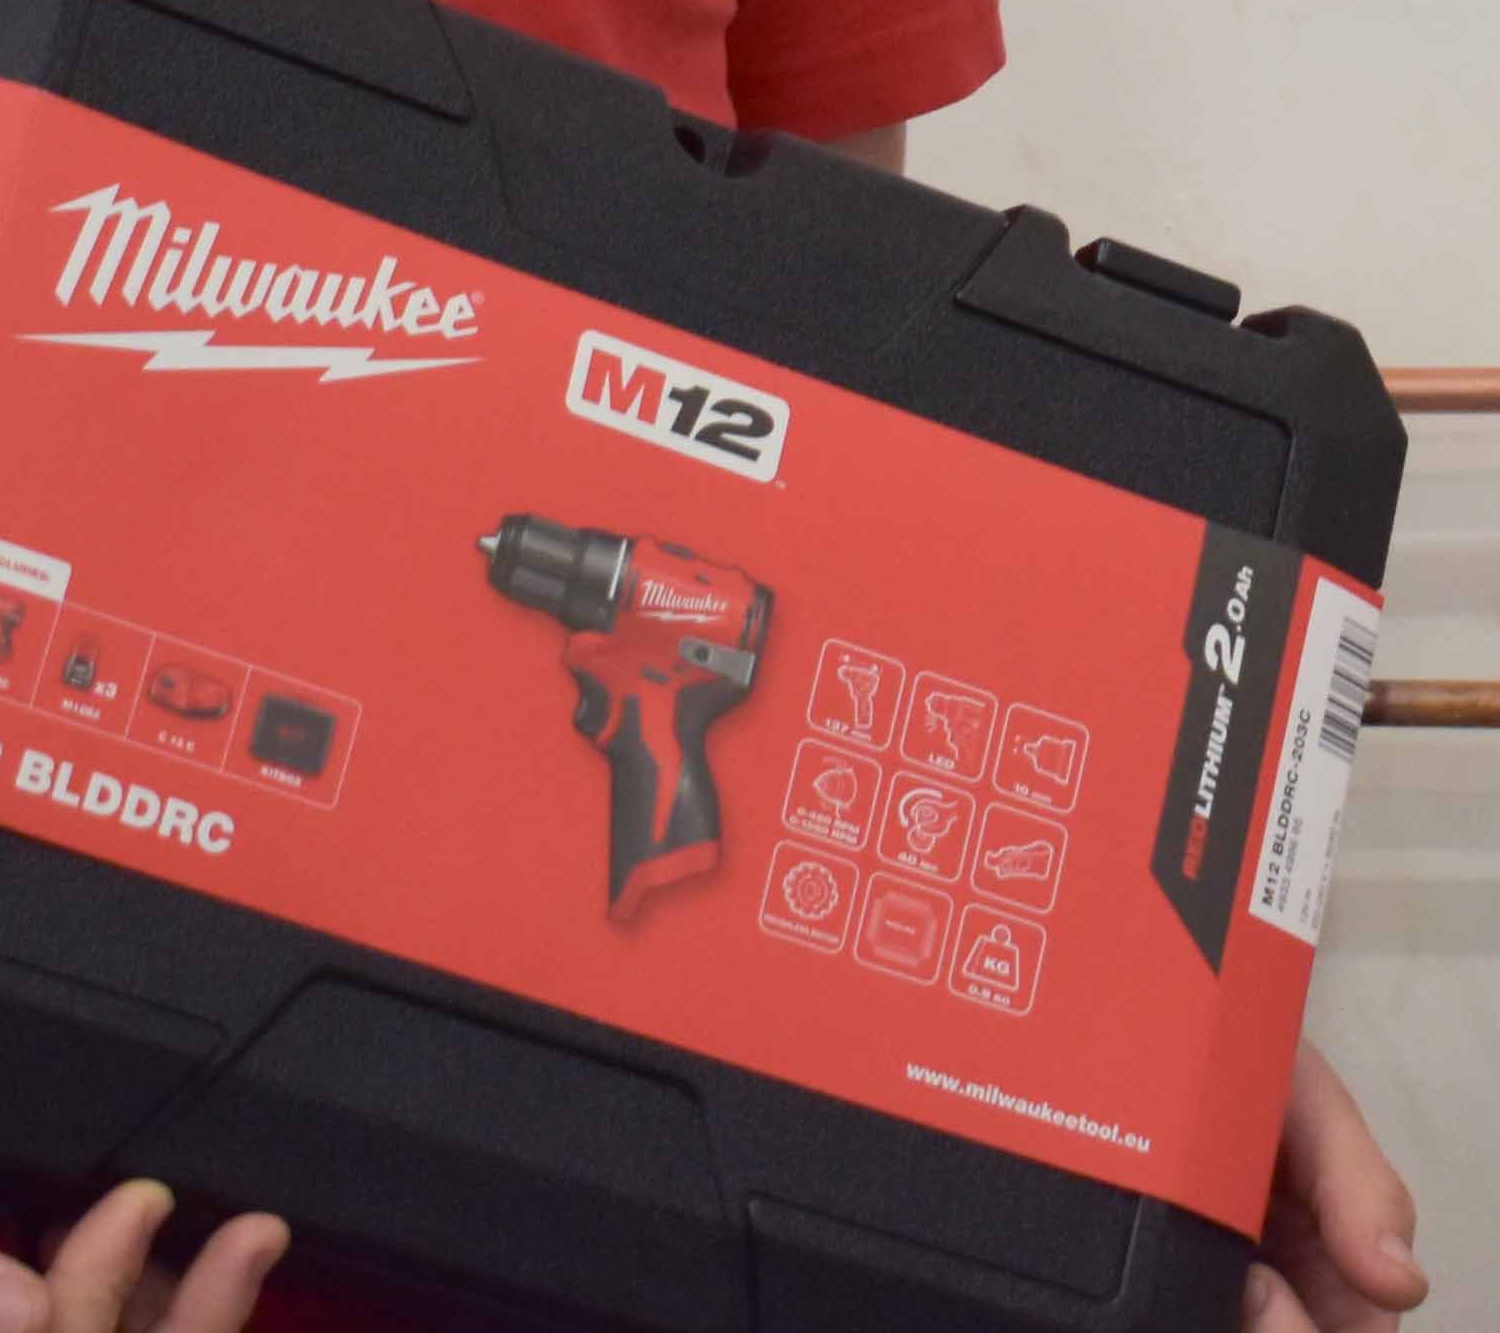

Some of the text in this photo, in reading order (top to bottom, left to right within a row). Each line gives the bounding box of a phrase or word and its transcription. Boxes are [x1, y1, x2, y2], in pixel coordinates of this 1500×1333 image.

[47, 182, 480, 340] Milwaukee
[582, 348, 775, 463] M12
[641, 580, 728, 612] Milwaukee
[15, 748, 236, 855] BLDDRC
[1262, 861, 1280, 907] M12
[1272, 708, 1311, 856] BLDDRC-203C
[983, 956, 1011, 976] KG
[906, 1062, 1152, 1153] www.milwaukeetool.eu
